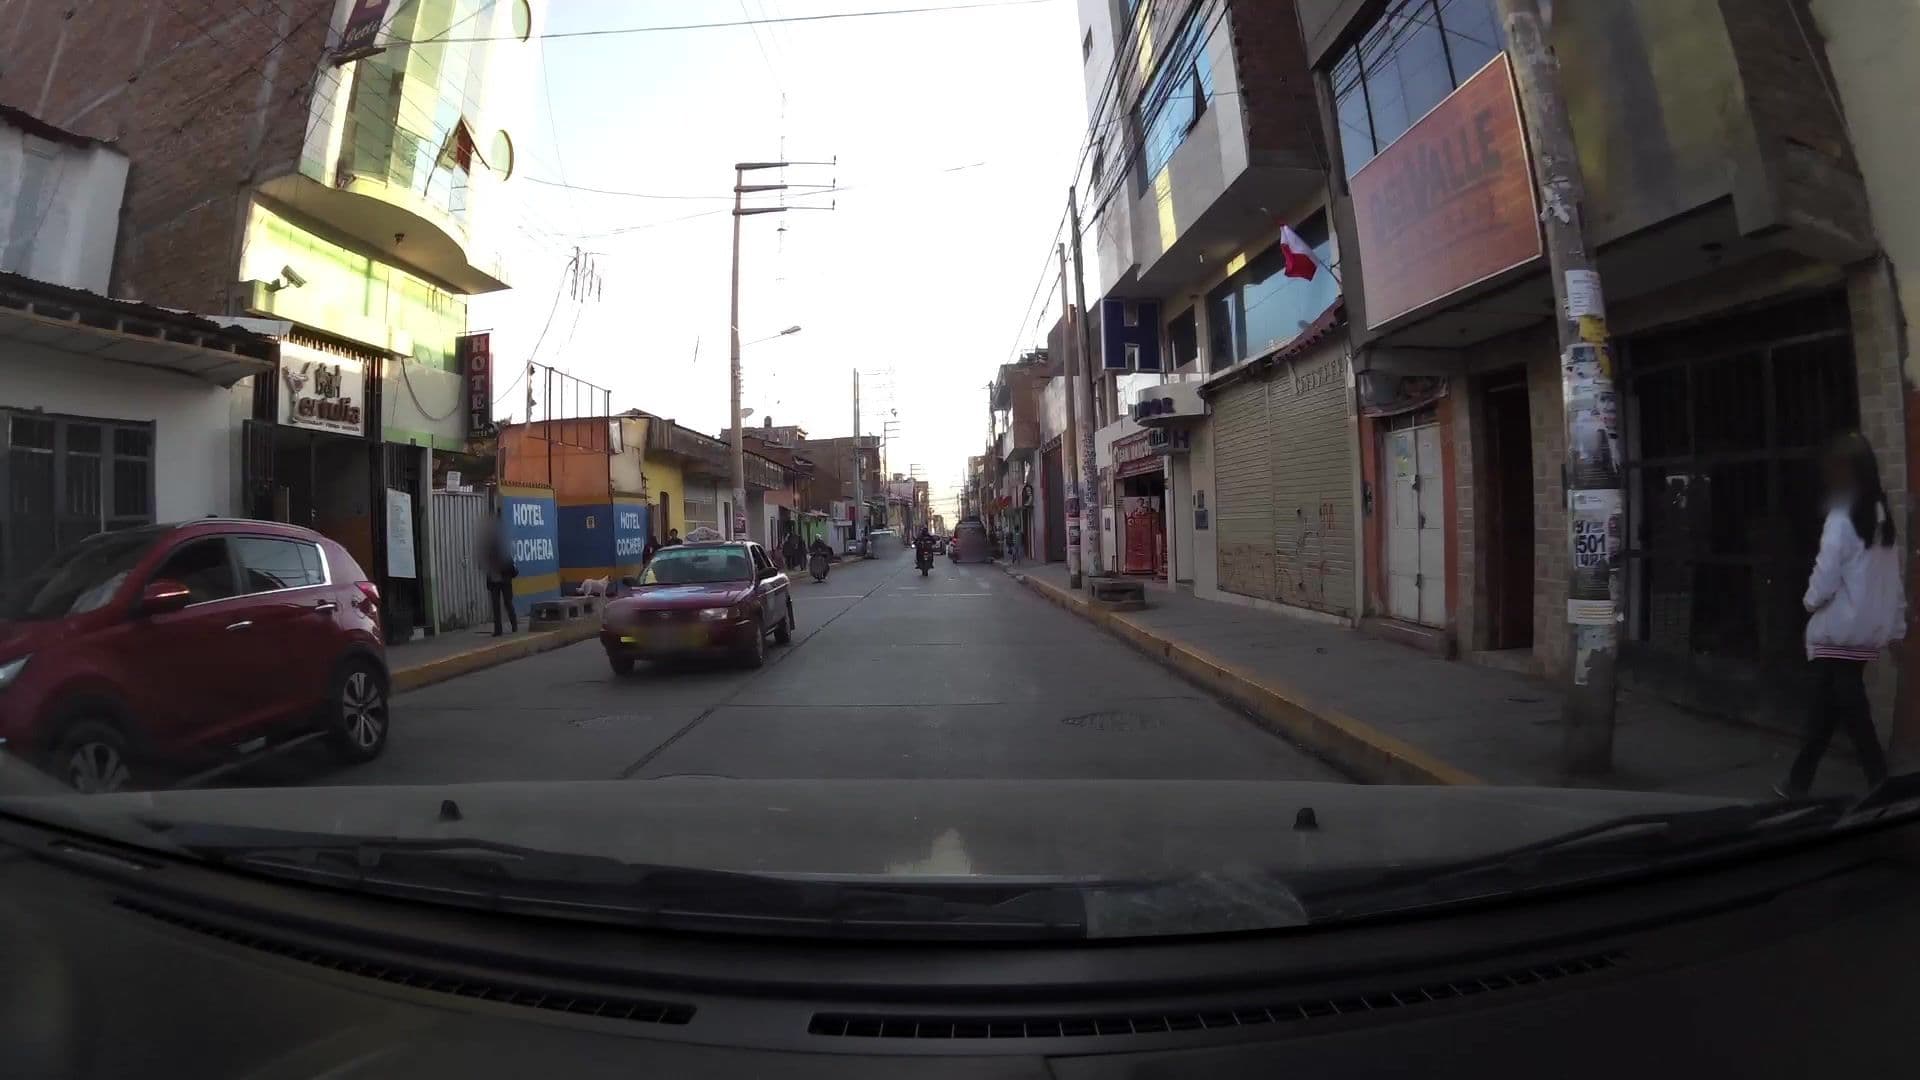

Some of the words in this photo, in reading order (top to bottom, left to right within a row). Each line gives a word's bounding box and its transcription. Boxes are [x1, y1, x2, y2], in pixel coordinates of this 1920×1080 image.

[472, 336, 486, 431] HOTEL
[513, 503, 545, 526] HOTEL
[620, 511, 641, 529] HOTEL
[1576, 534, 1606, 554] 501
